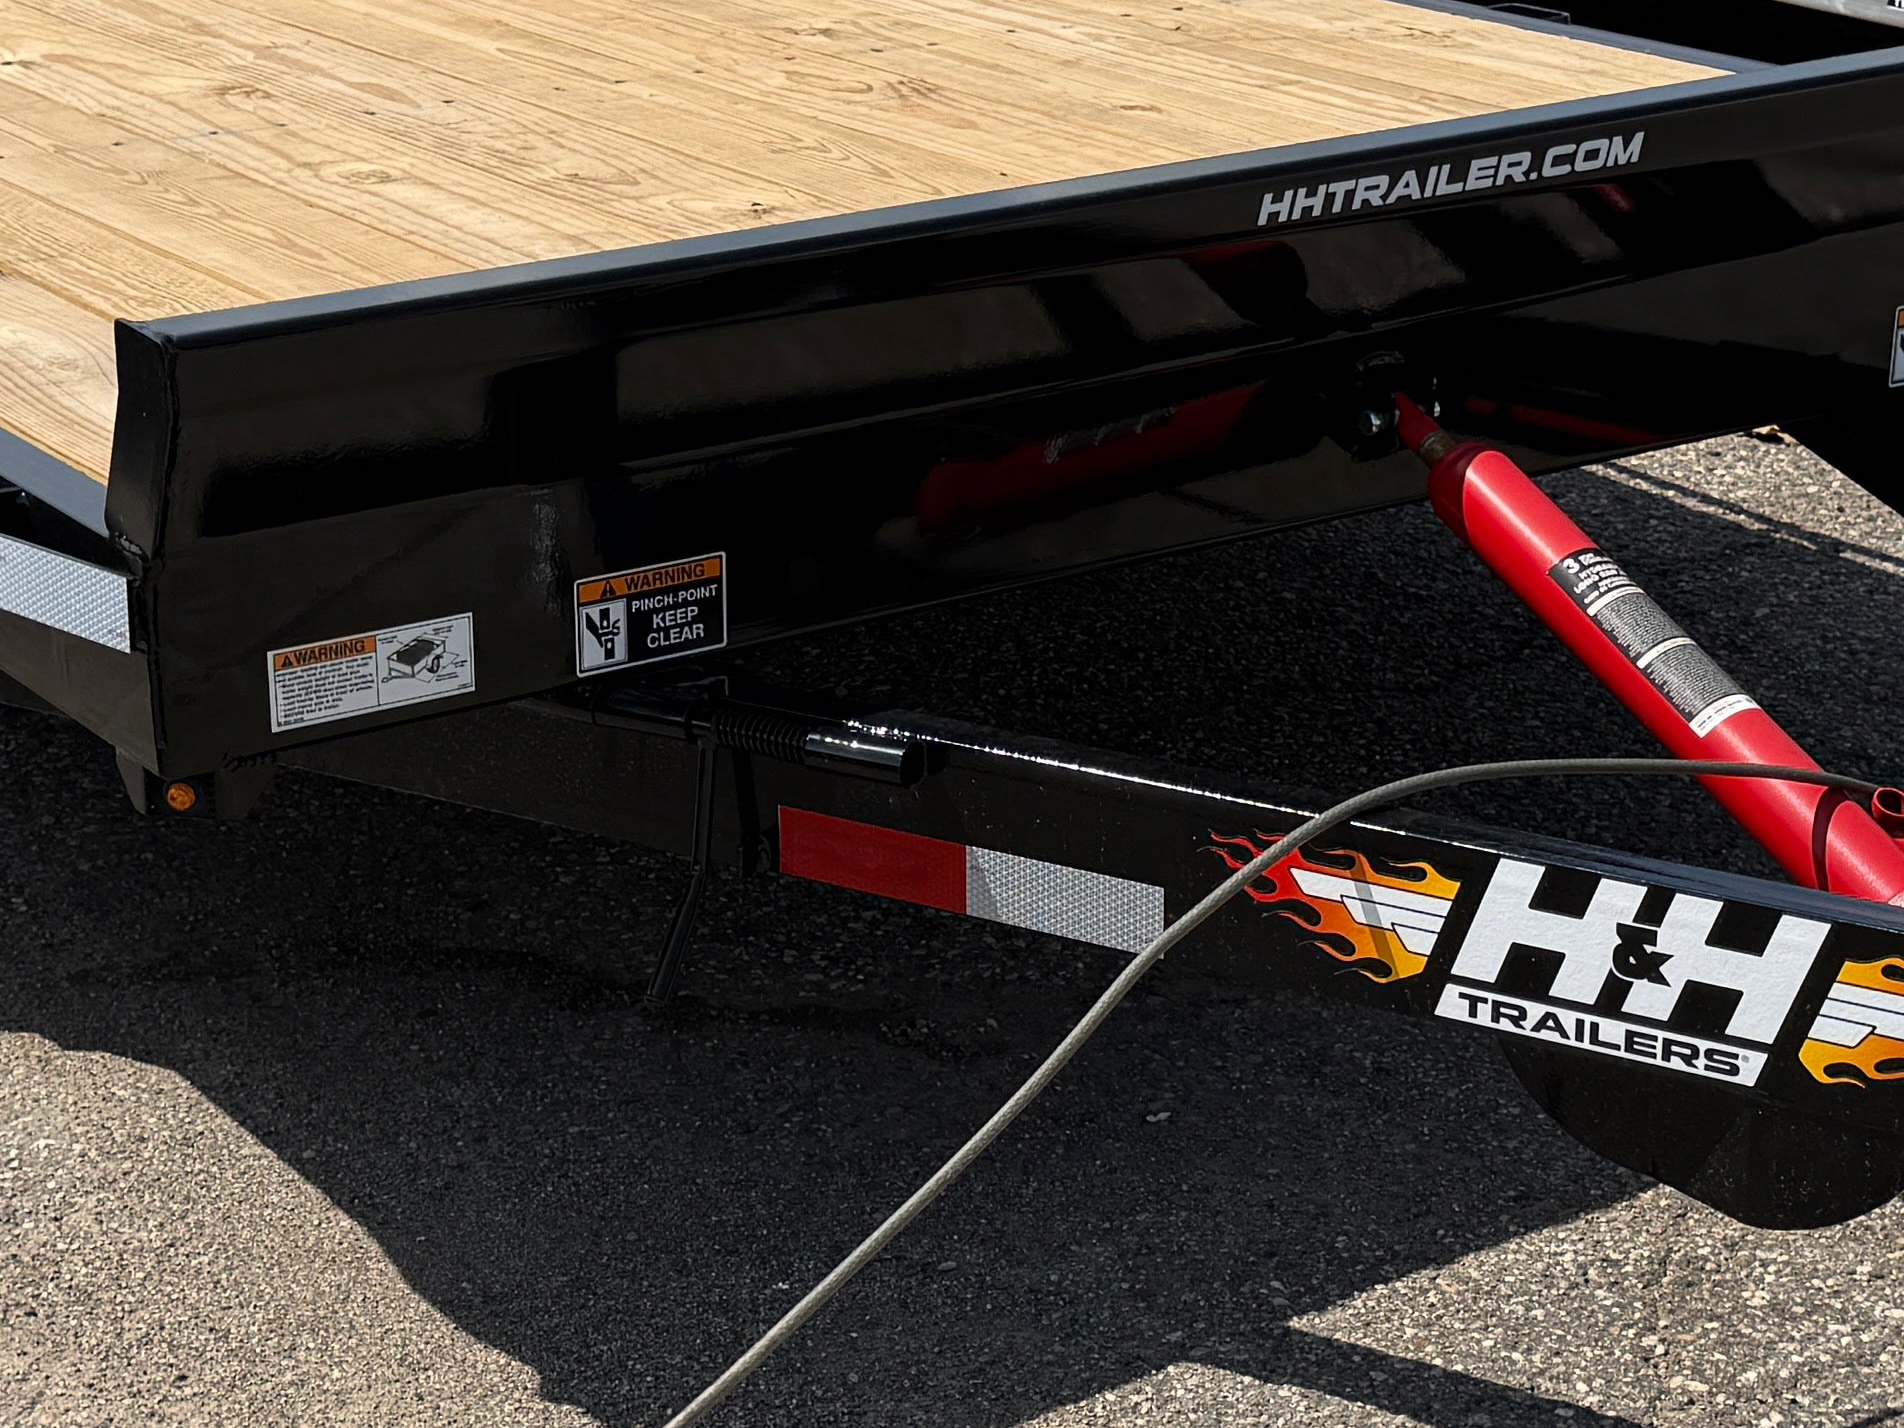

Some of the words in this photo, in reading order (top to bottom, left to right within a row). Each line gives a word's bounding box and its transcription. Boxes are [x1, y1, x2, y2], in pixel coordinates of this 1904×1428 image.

[1257, 131, 1645, 226] HHTRAILER.COM
[623, 563, 705, 592] WARNING
[632, 584, 718, 612] PINCH-POINT
[653, 606, 698, 629] KEEP
[647, 623, 704, 648] CLEAR
[295, 639, 366, 665] WARNING
[1451, 858, 1832, 1044] H&H
[1458, 992, 1741, 1077] TRAILERS
